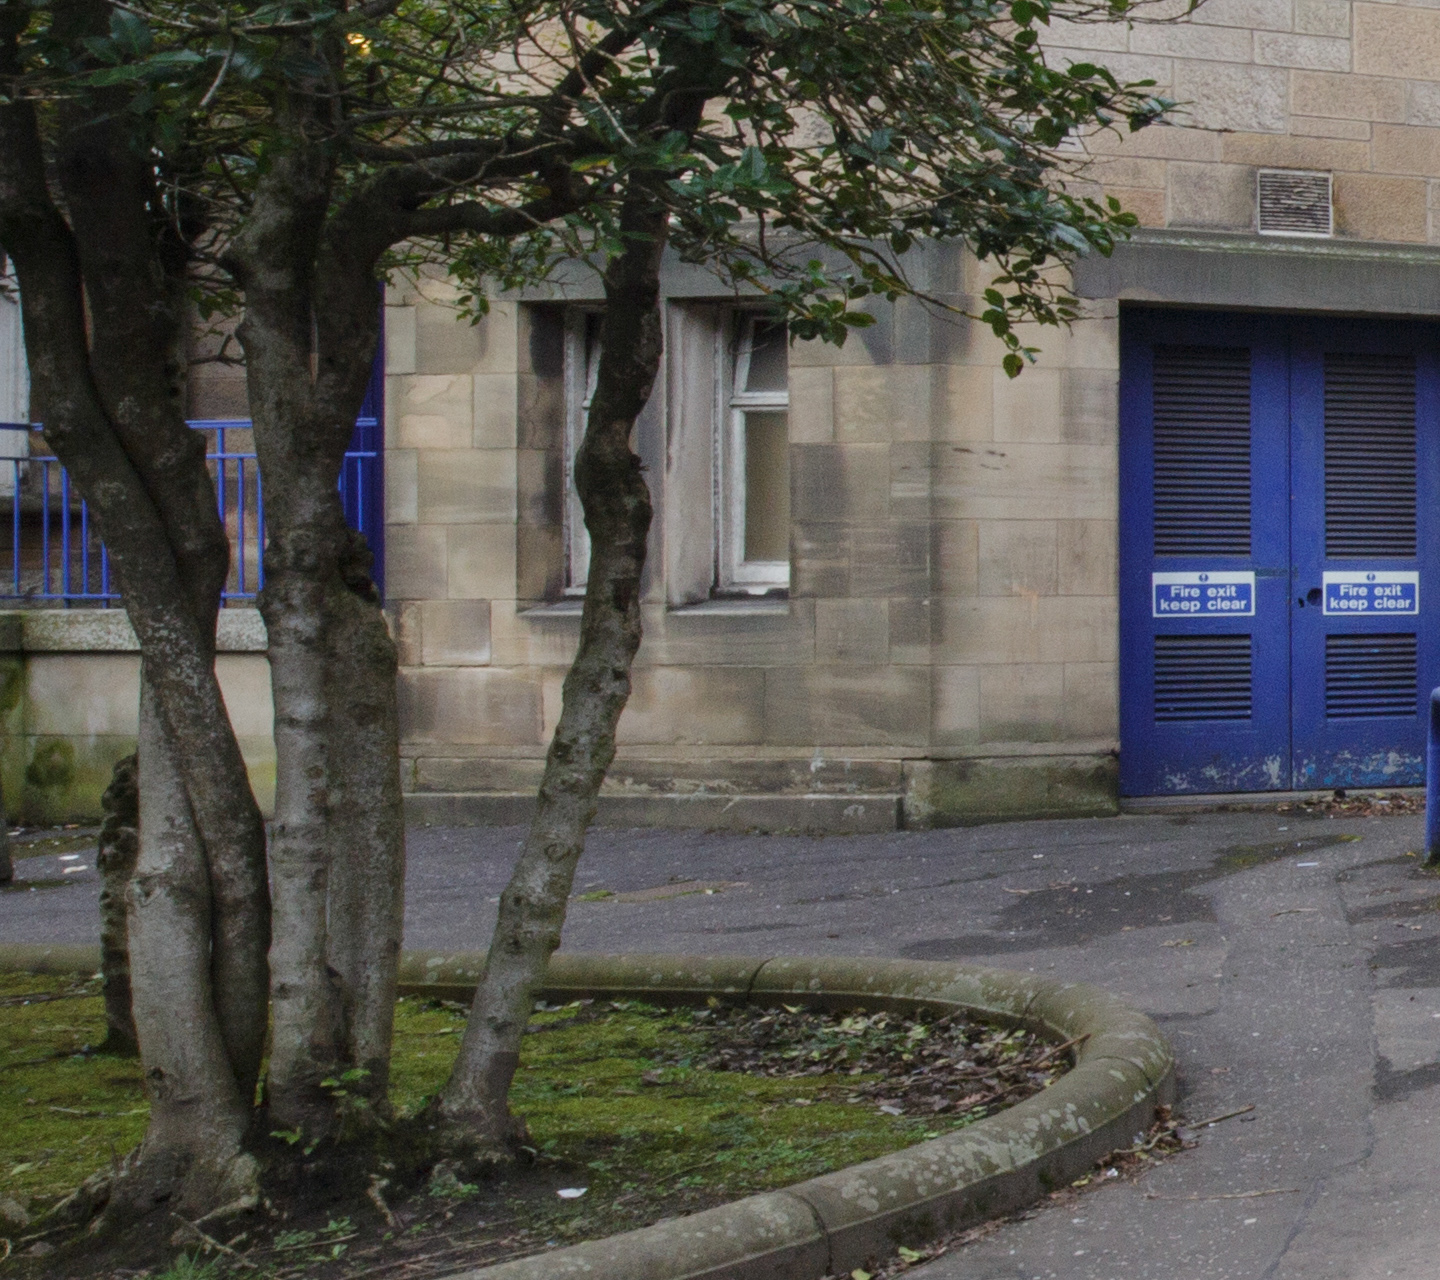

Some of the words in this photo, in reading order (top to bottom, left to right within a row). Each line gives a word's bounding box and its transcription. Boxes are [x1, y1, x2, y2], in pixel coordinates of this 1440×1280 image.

[1171, 585, 1200, 598] Fire
[1207, 585, 1237, 598] exit
[1340, 584, 1368, 597] Fire
[1374, 584, 1402, 597] exit
[1160, 599, 1201, 613] keep
[1207, 599, 1247, 611] clear
[1330, 597, 1368, 611] keep
[1374, 597, 1411, 609] clear
